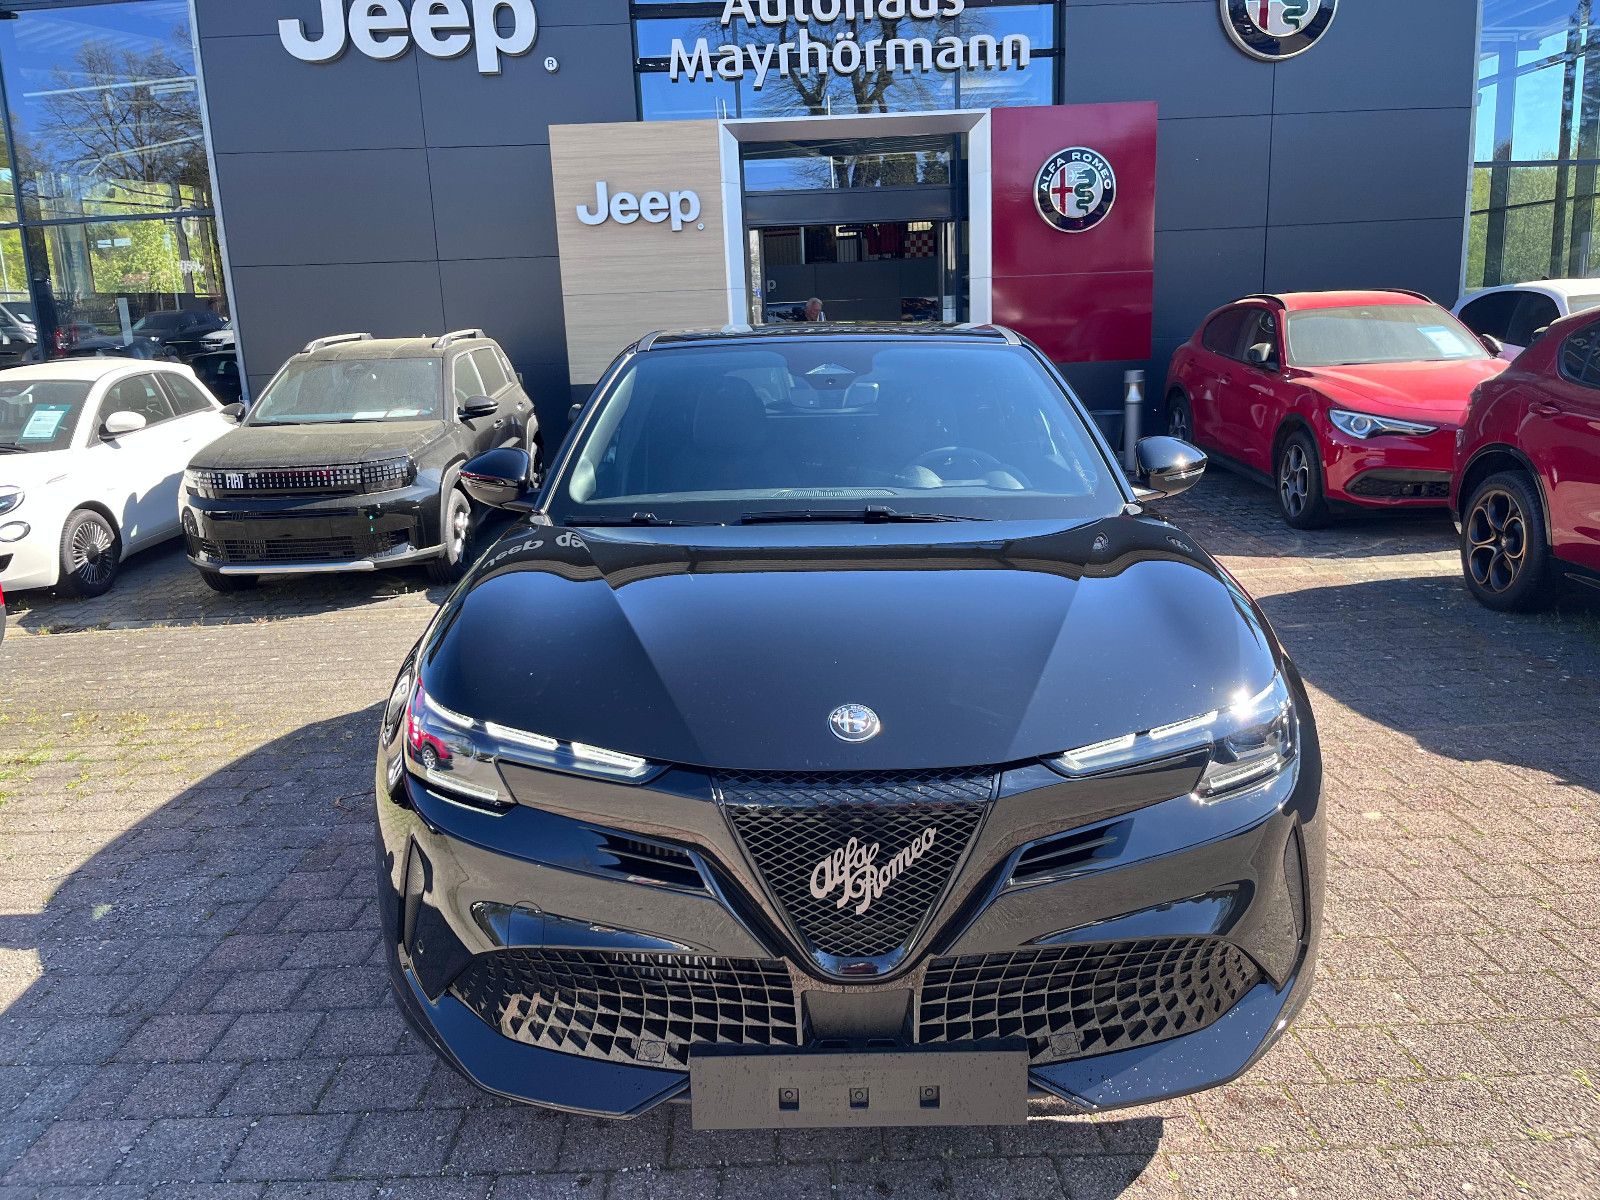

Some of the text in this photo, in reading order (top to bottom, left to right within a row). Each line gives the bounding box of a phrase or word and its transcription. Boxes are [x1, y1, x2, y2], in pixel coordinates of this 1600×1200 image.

[278, 0, 538, 74] Jeep
[669, 28, 1031, 89] Mayrhörmann
[1041, 152, 1112, 192] ALFA ROMEO
[576, 181, 701, 232] Jeep
[225, 473, 244, 489] FIAT
[847, 826, 937, 916] Romeo
